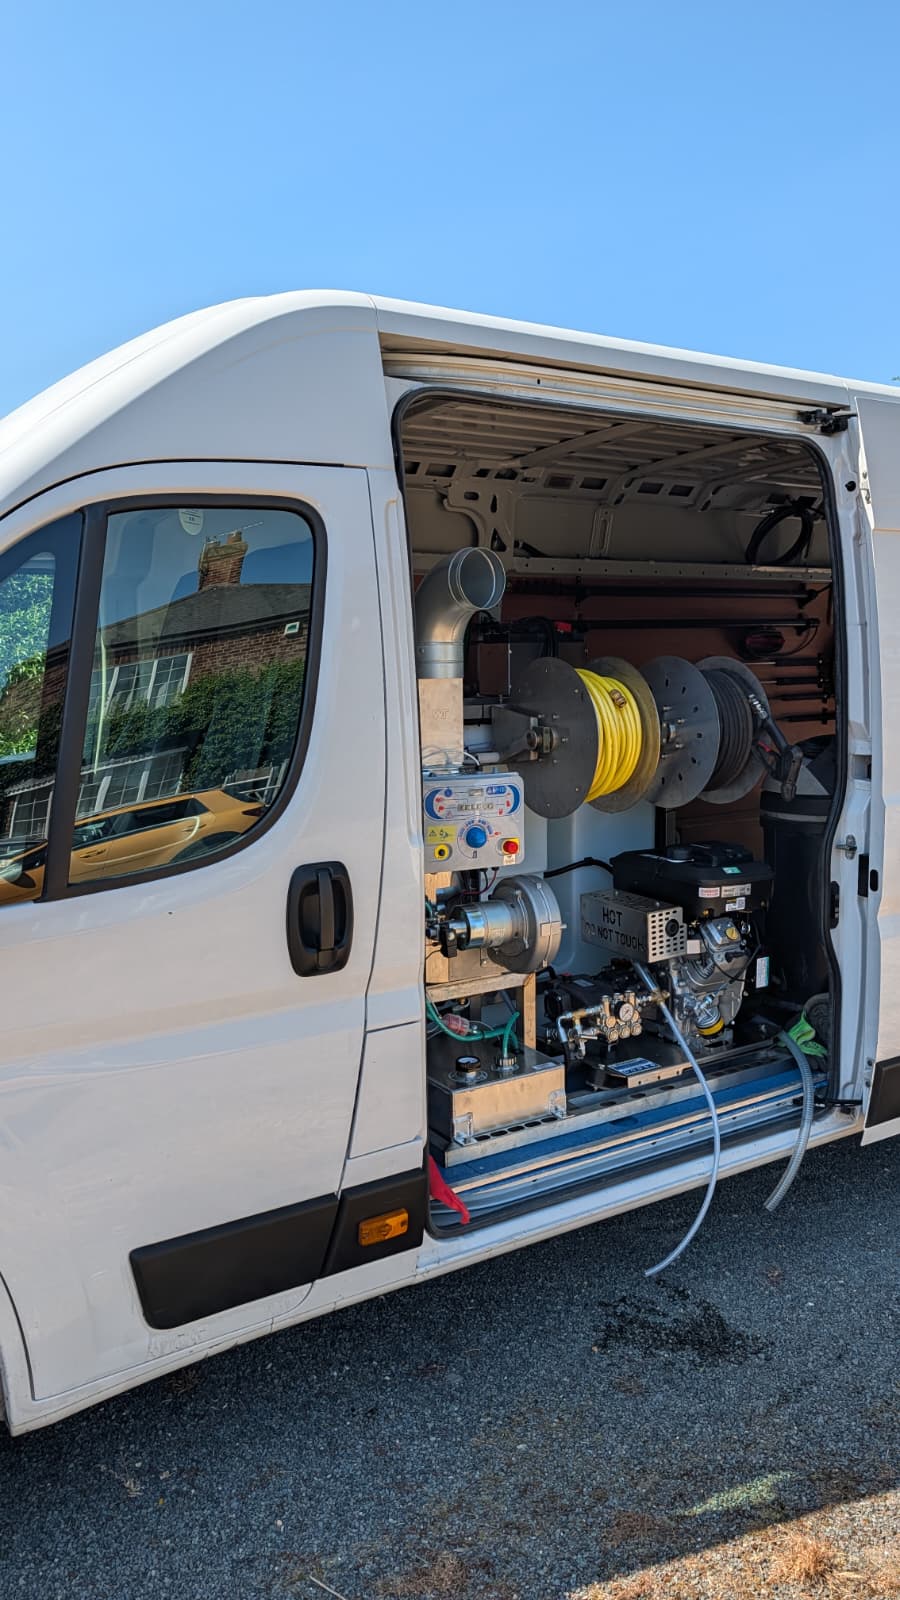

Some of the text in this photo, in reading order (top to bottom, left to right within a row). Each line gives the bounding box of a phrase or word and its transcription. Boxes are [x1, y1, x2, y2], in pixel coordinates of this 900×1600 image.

[602, 905, 623, 928] HOT
[583, 922, 596, 937] DO
[597, 927, 614, 942] NOT
